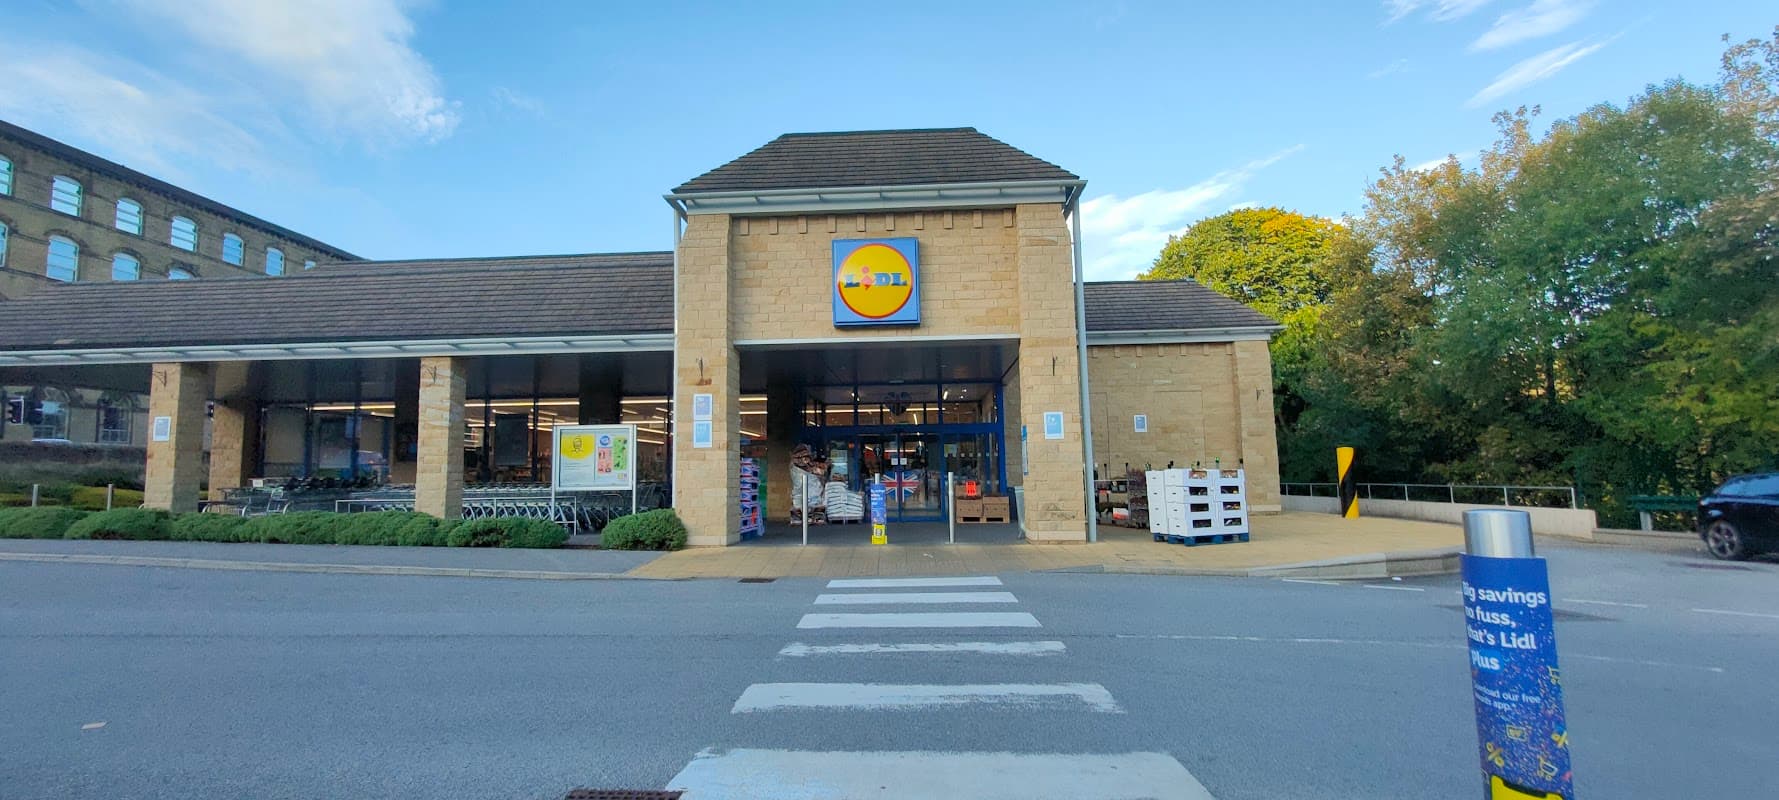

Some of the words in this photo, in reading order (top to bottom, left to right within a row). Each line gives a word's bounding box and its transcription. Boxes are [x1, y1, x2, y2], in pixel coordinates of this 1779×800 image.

[1478, 587, 1547, 608] savings
[1476, 605, 1516, 628] fuss,
[1500, 631, 1537, 649] Lidl
[1471, 649, 1501, 670] Plus
